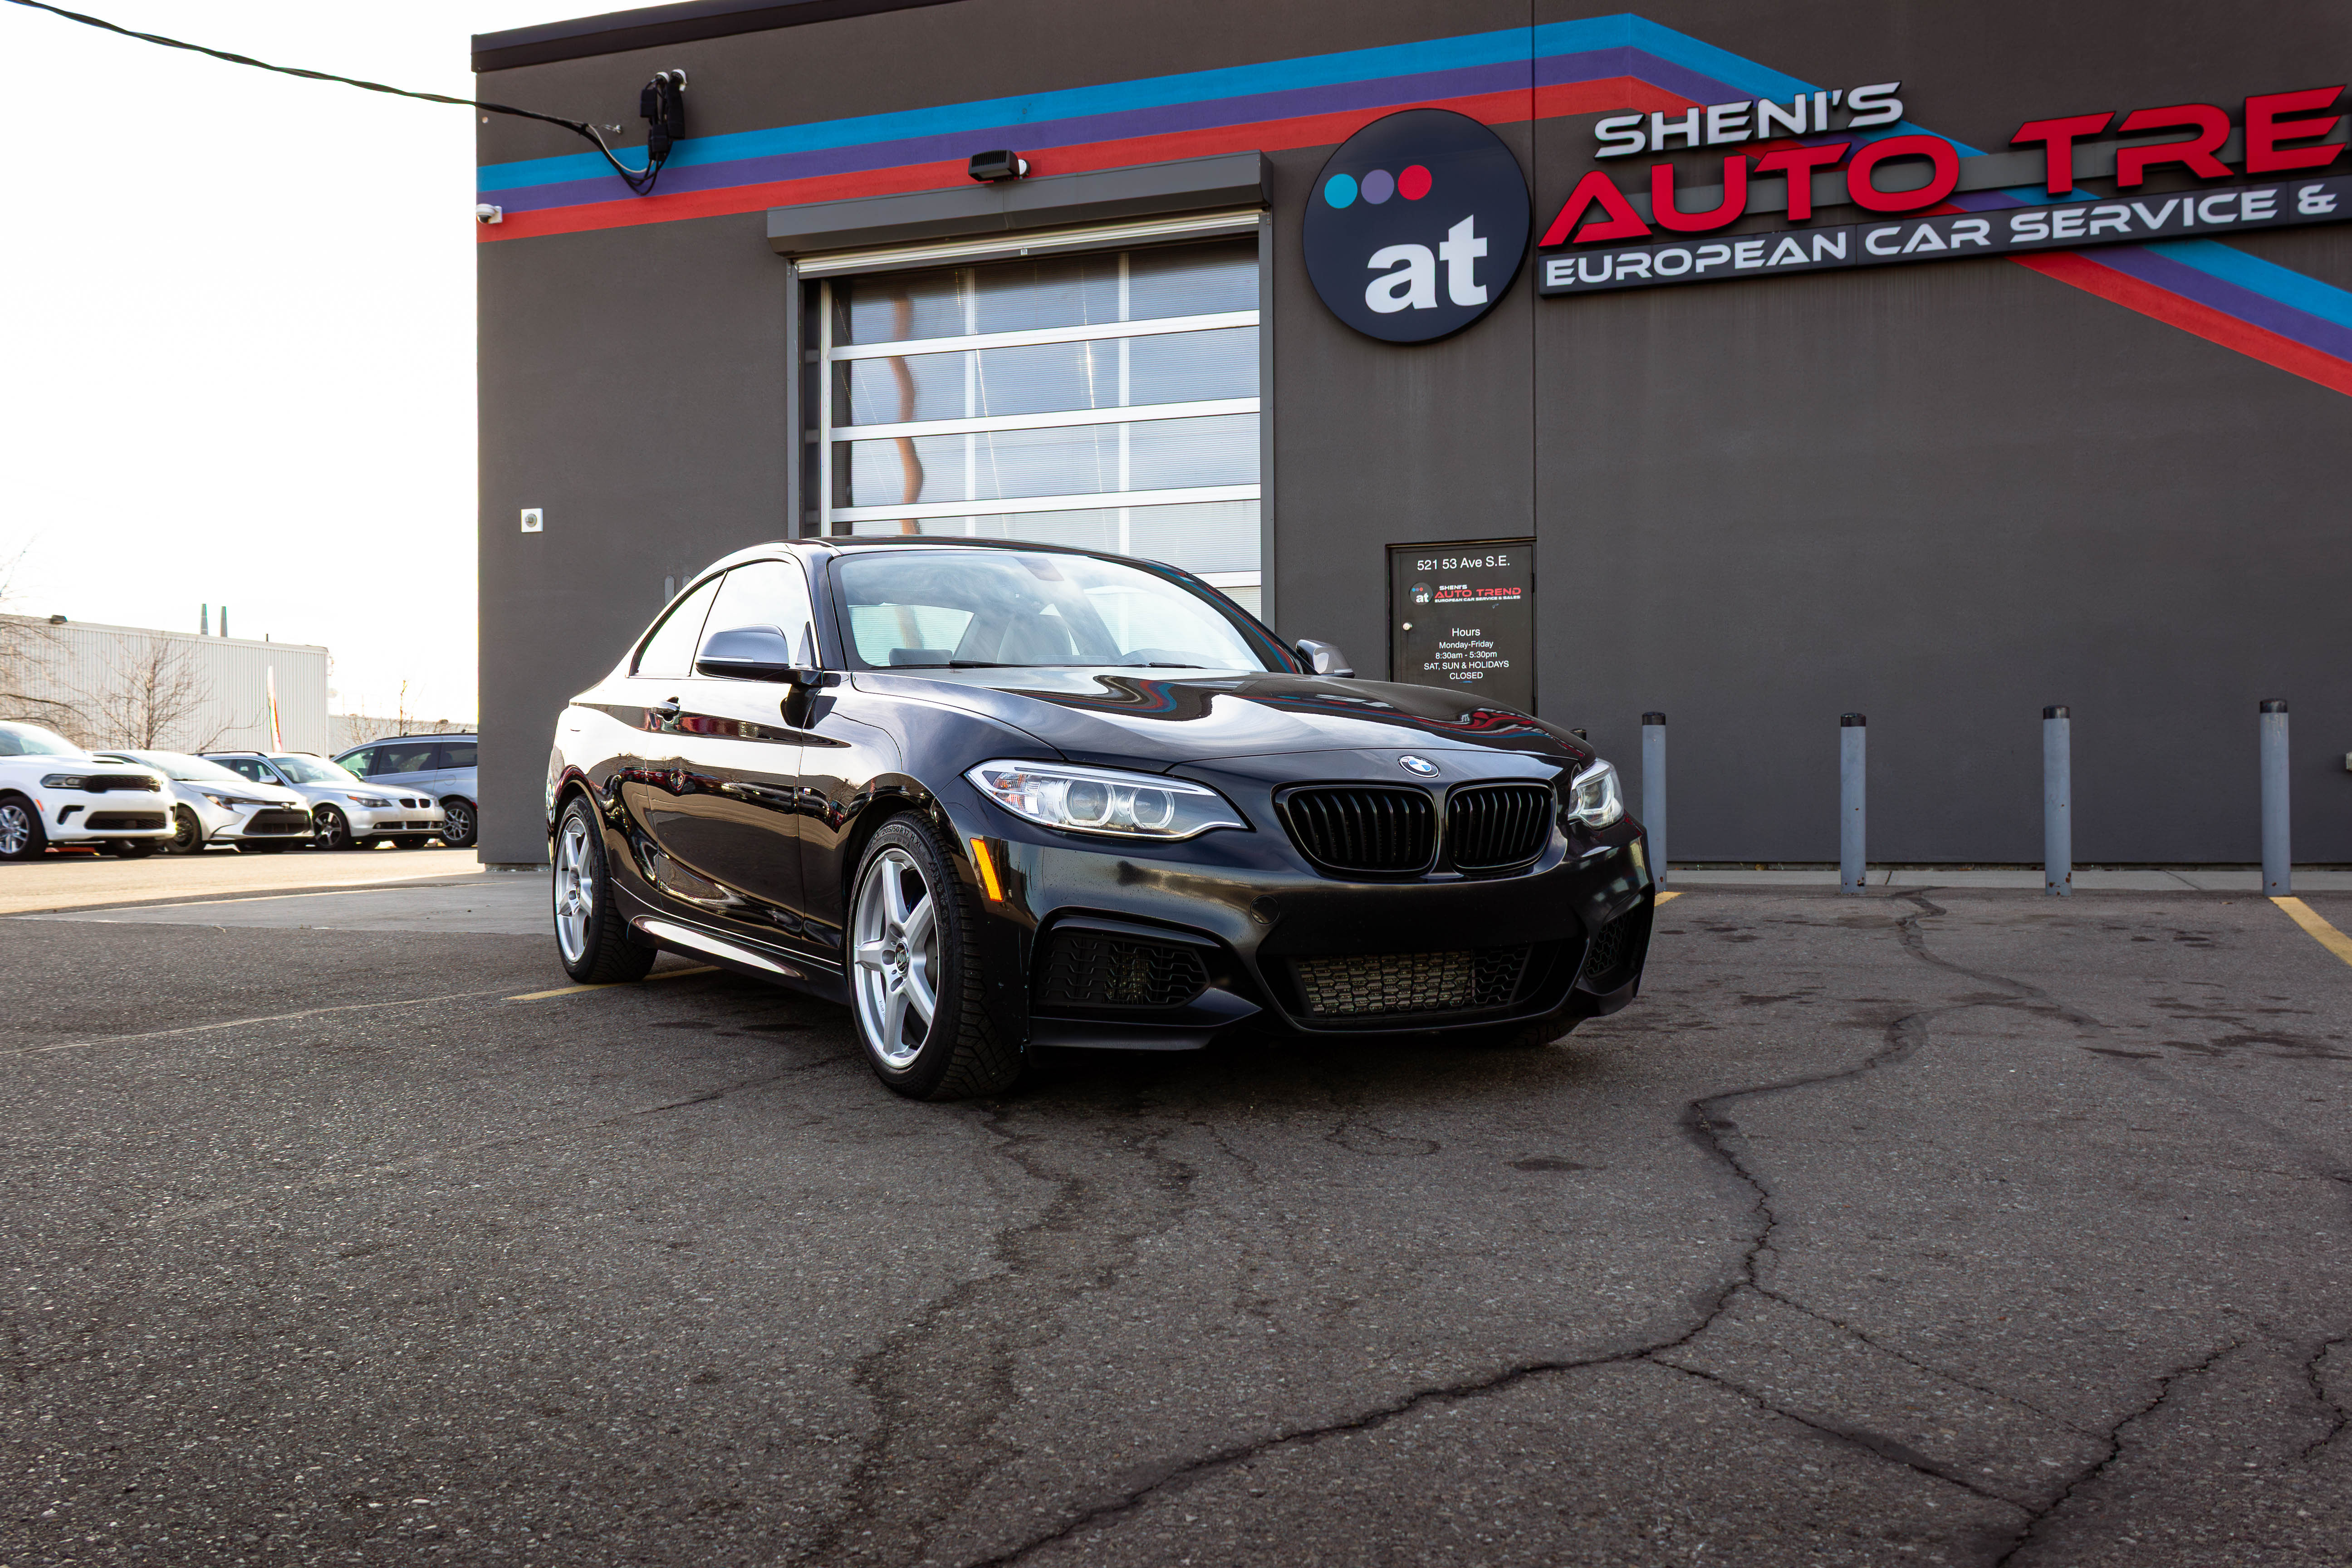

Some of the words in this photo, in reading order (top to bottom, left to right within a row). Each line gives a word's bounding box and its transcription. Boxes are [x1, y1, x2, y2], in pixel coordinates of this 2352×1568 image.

[1595, 82, 1903, 157] SHENI'S
[1539, 135, 1962, 247] AUTO
[2011, 86, 2346, 193] TRE
[1547, 233, 1846, 286] EUROPEAN
[1865, 219, 1990, 255] CAR
[2010, 189, 2278, 243] SERVICE
[2298, 185, 2337, 214] &
[1365, 215, 1487, 313] at
[1417, 560, 1436, 570] 521
[1443, 559, 1456, 569] 53
[1460, 558, 1482, 568] Ave
[1486, 555, 1509, 567] S.E.
[1416, 593, 1428, 603] at
[1435, 590, 1472, 598] AUTO
[1476, 588, 1521, 596] TREND
[1452, 628, 1480, 637] Hours
[1440, 641, 1493, 649] Monday-Friday
